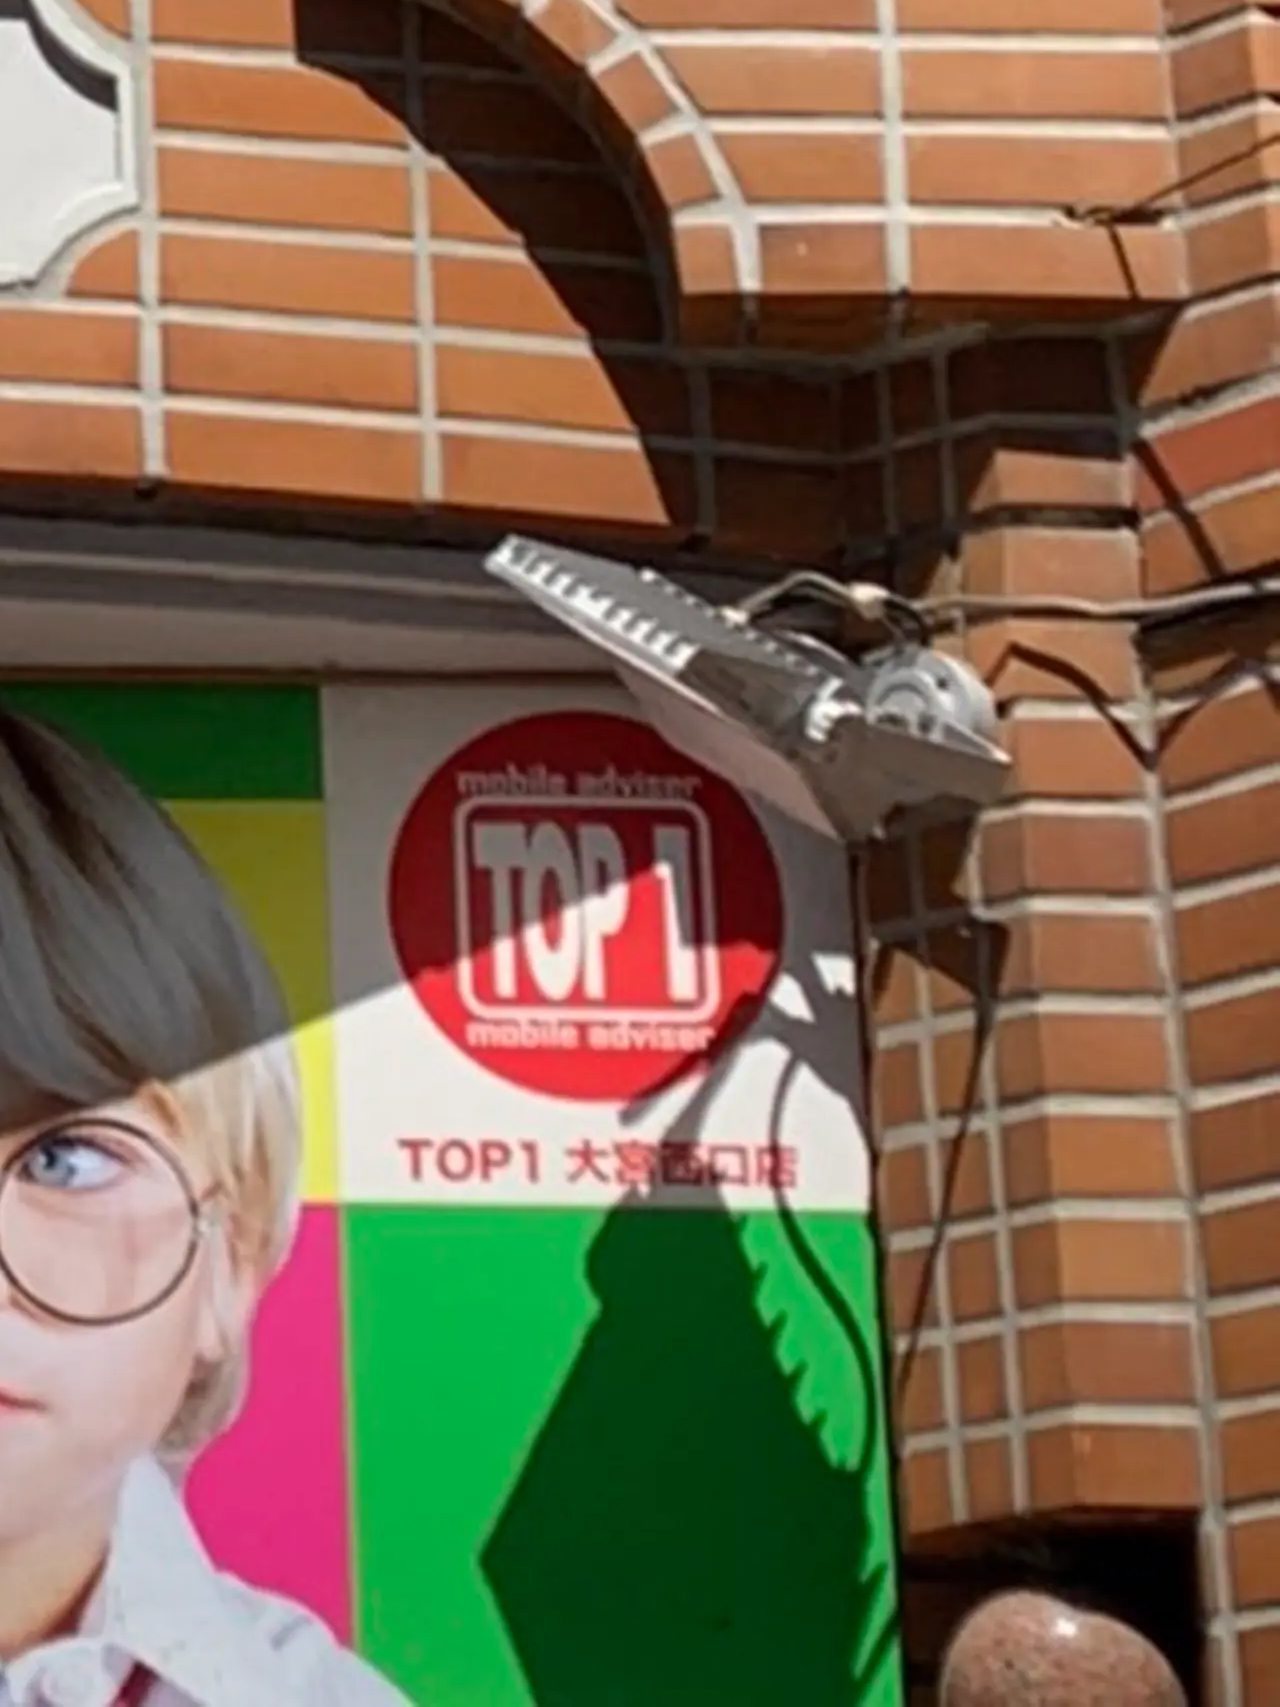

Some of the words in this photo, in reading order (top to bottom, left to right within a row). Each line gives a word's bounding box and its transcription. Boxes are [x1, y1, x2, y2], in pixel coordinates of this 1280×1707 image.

[457, 762, 566, 798] mobile
[466, 1018, 578, 1050] mobile
[397, 1139, 541, 1183] TOP1
